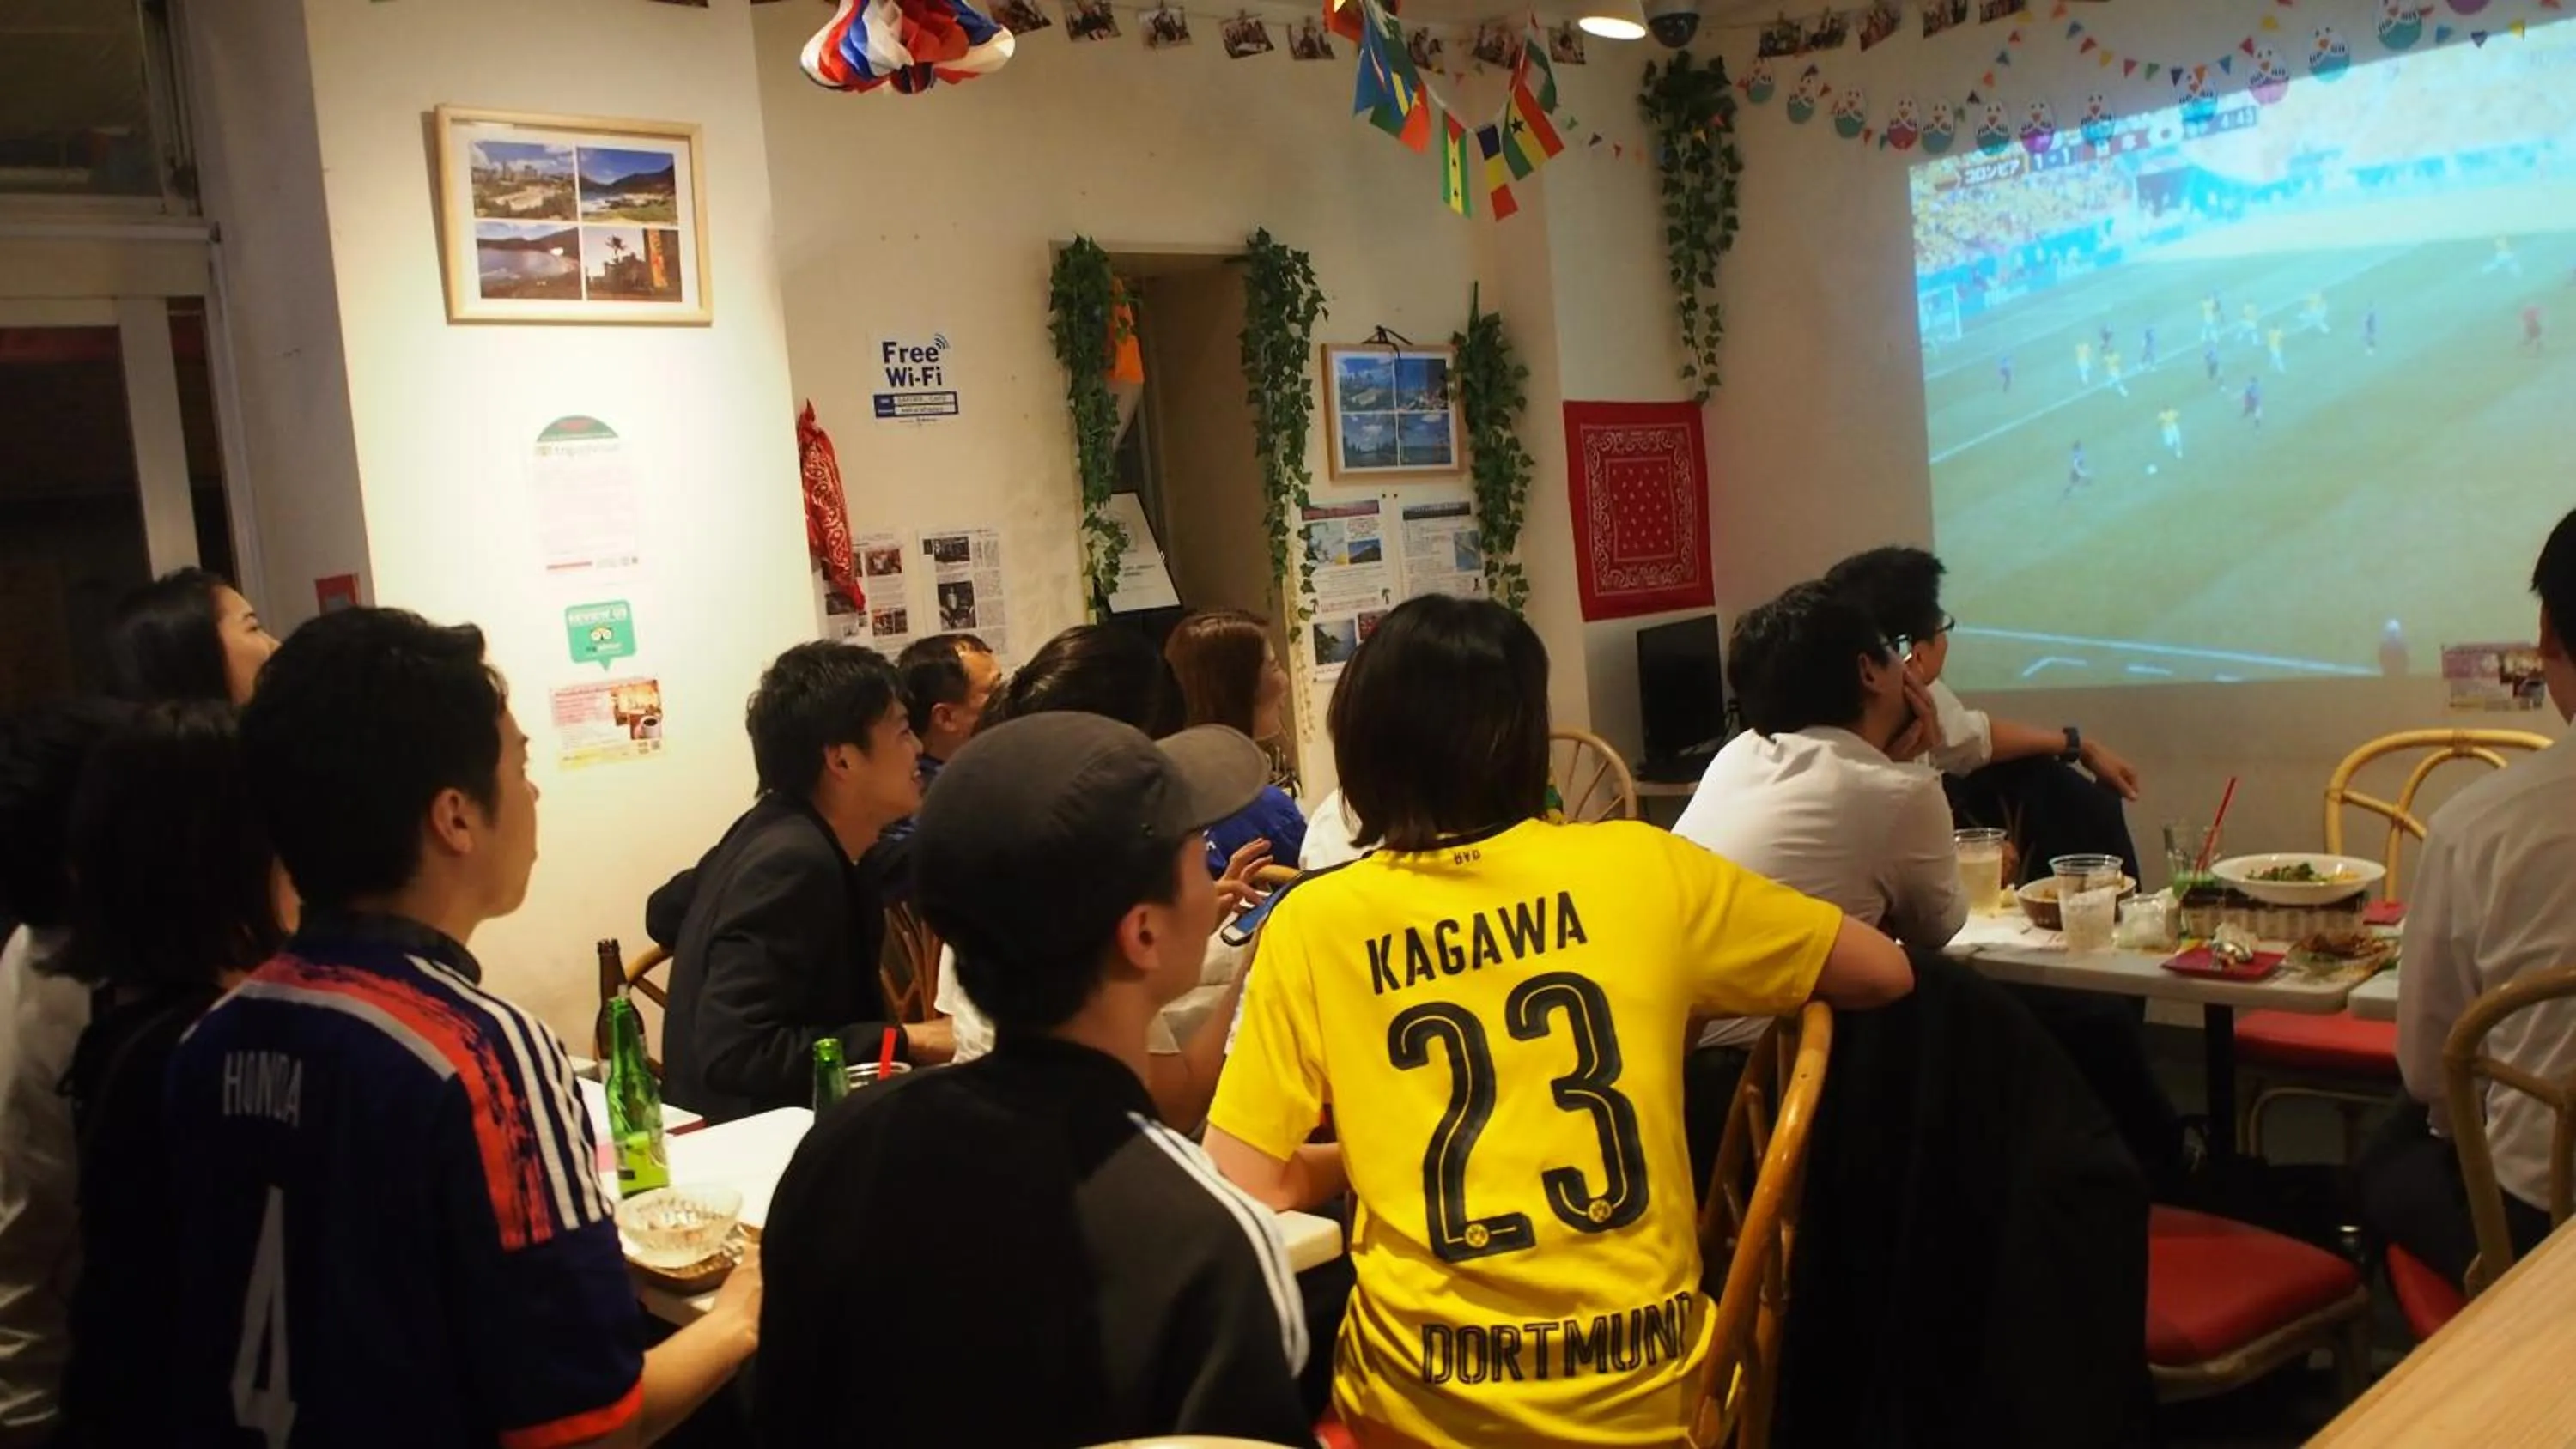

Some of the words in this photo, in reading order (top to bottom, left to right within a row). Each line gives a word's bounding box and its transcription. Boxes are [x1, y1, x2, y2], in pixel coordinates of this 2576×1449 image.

[882, 341, 939, 363] Free
[885, 367, 942, 387] Wi-Fi
[1366, 891, 1588, 994] KAGAWA
[222, 1051, 303, 1128] HONDA
[1388, 972, 1650, 1263] 23
[230, 1185, 298, 1449] 4
